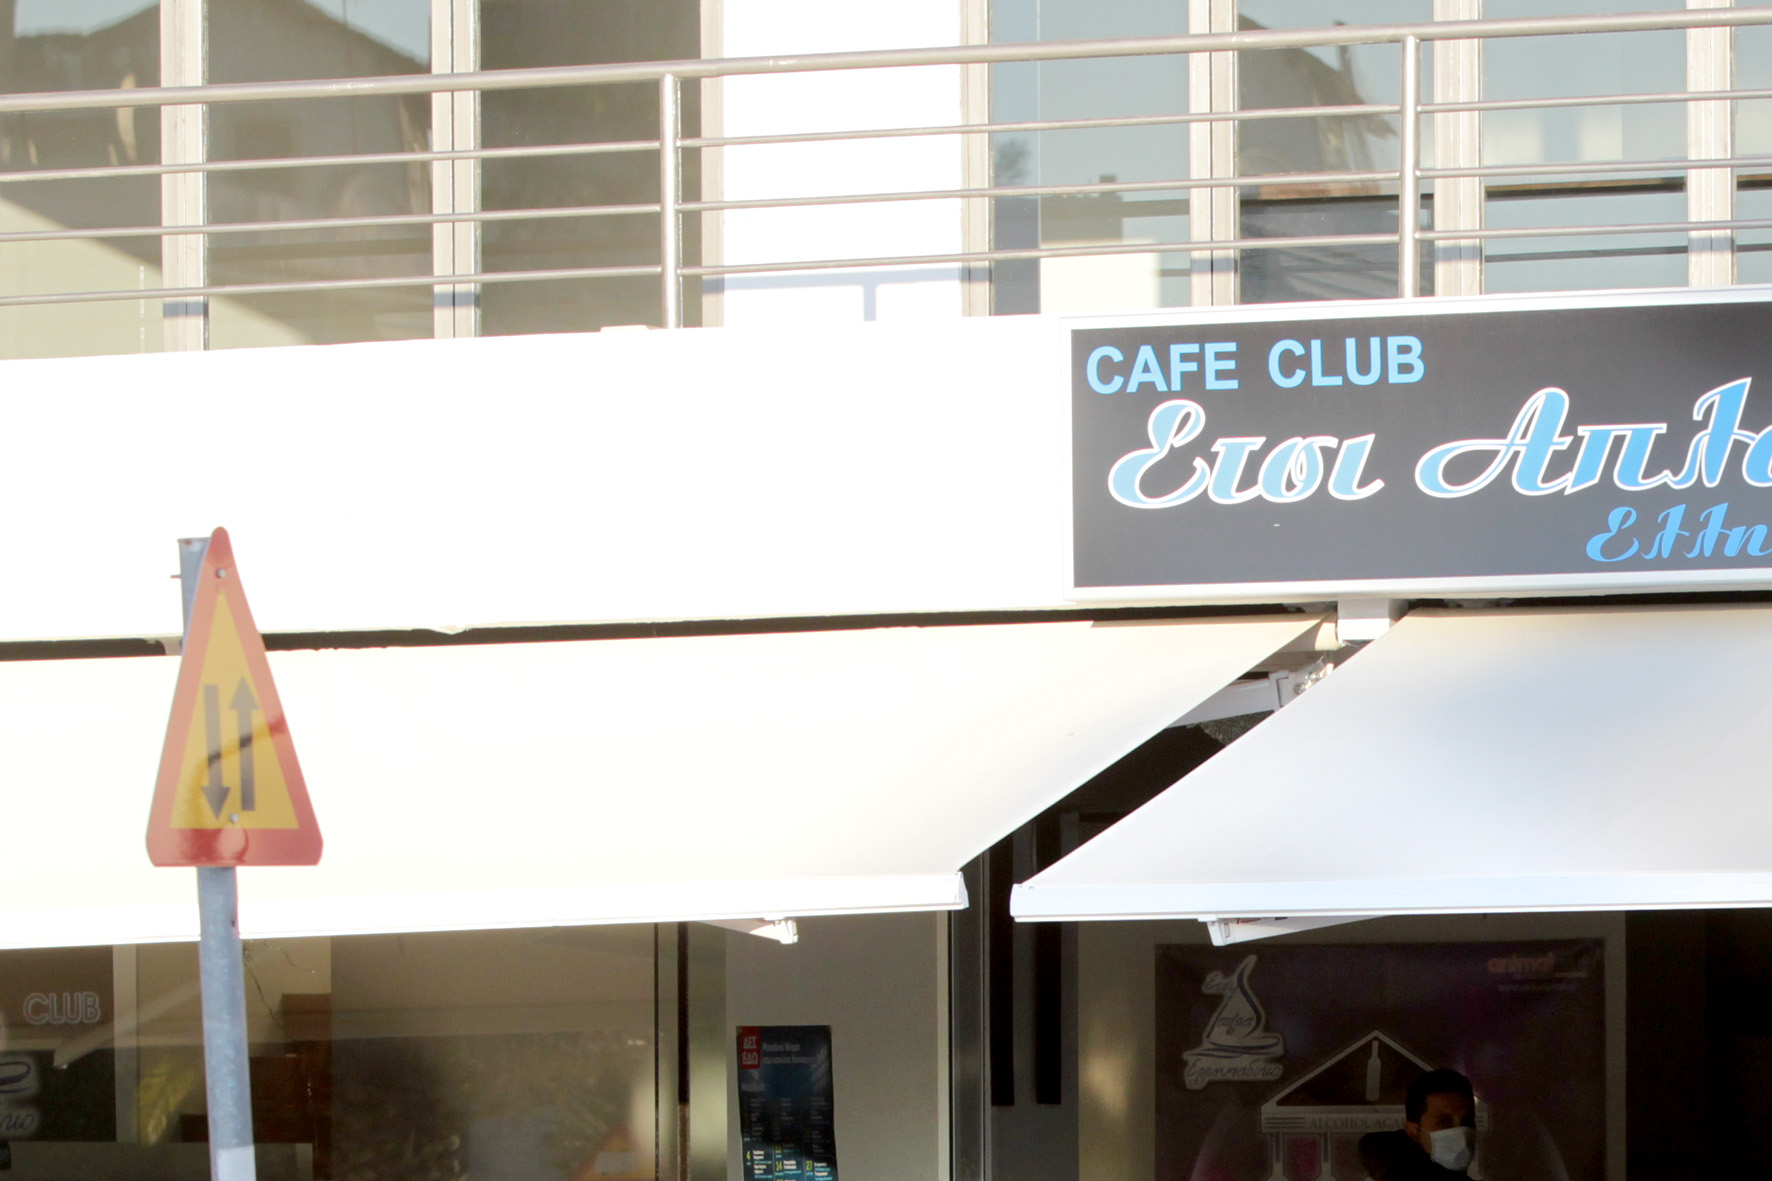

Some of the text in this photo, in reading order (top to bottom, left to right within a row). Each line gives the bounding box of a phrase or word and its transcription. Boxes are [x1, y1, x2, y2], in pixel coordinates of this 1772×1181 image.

[1085, 334, 1426, 395] CAFE CLUB
[23, 991, 101, 1026] CLUB
